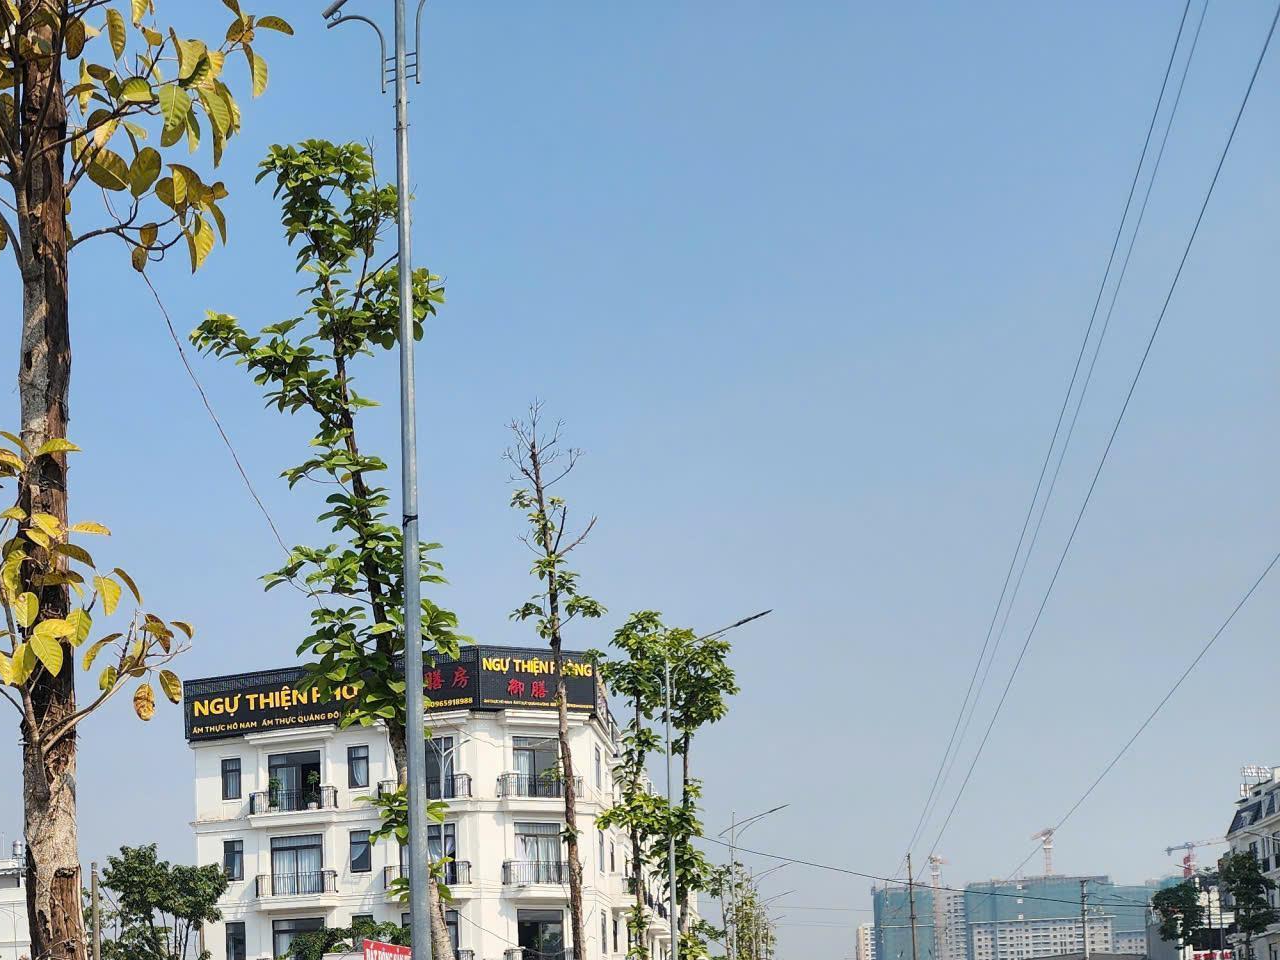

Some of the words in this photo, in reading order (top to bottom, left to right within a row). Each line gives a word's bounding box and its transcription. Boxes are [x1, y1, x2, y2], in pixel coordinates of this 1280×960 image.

[482, 657, 511, 674] NGỰ
[513, 657, 550, 676] THIỆN
[194, 693, 241, 717] NGỰ
[246, 685, 308, 710] THIỆN
[239, 721, 257, 729] NAM
